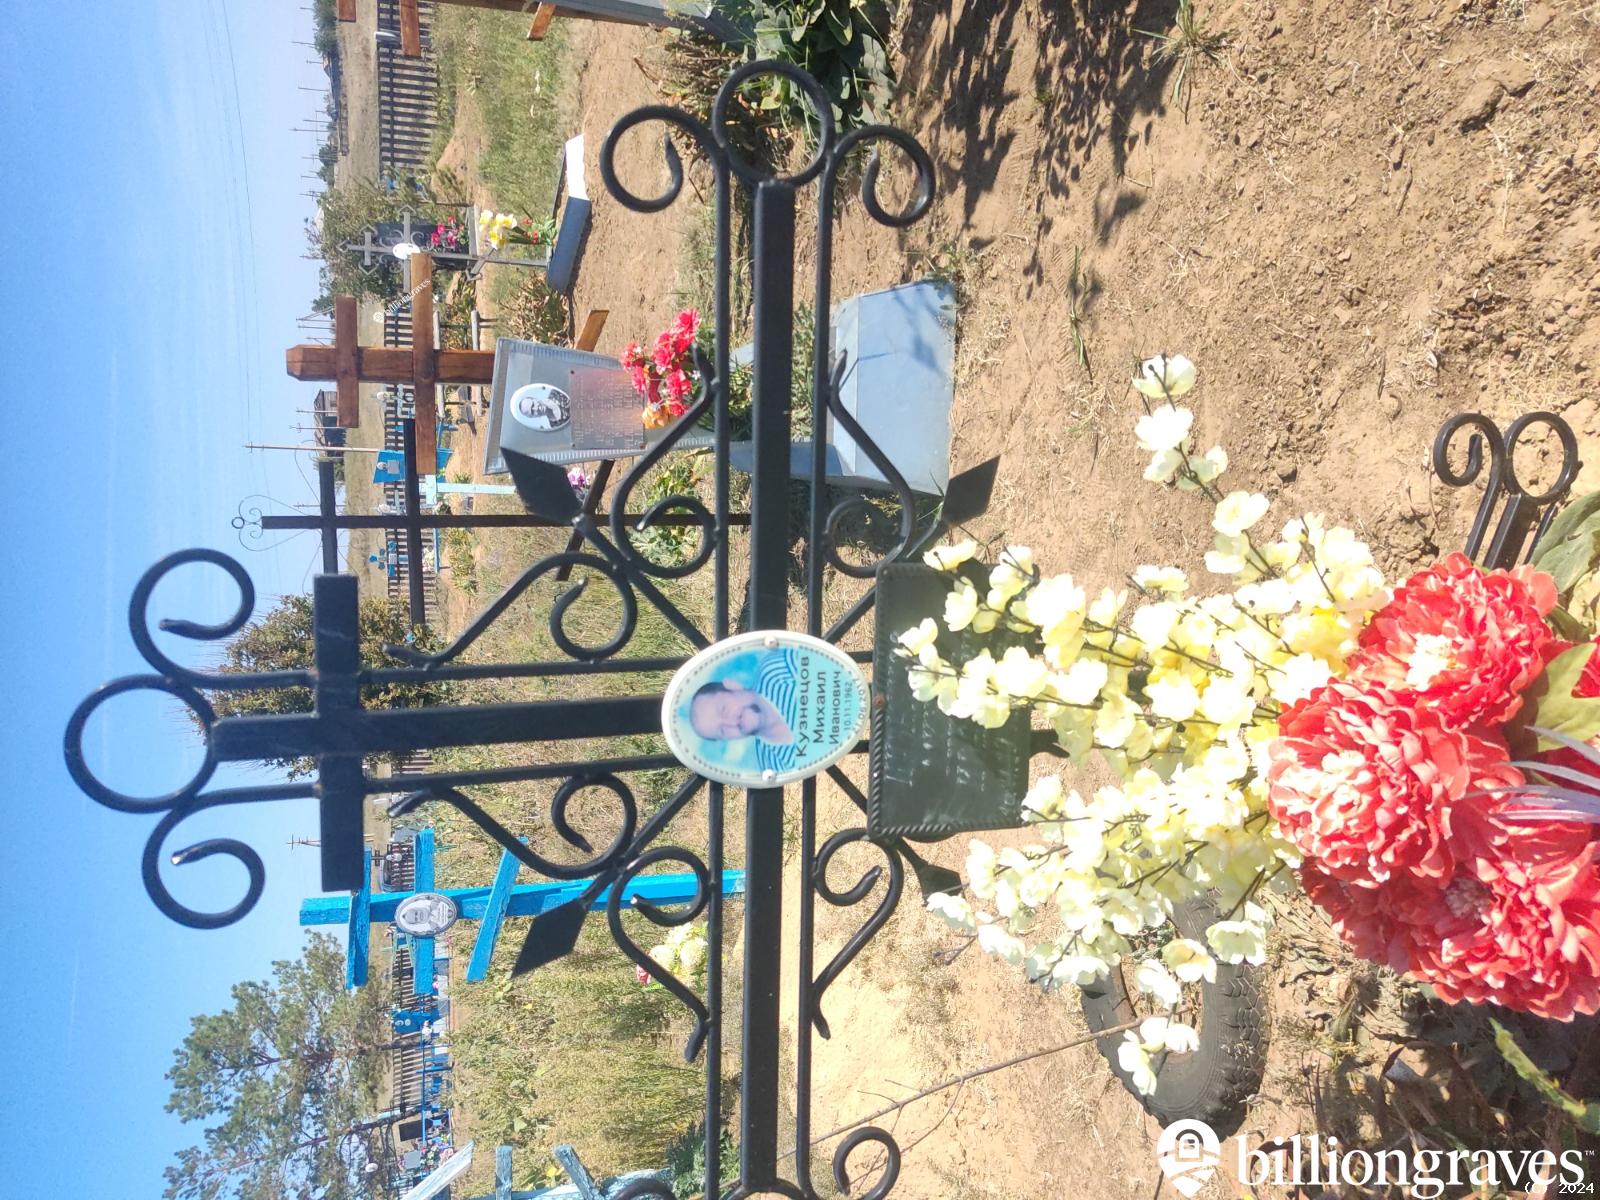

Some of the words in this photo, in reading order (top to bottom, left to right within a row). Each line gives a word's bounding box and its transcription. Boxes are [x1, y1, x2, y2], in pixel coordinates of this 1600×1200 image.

[796, 656, 811, 757] Кузнецов
[813, 672, 826, 743] Михаил
[829, 671, 841, 744] Иванович
[844, 681, 853, 731] 10.11.1962
